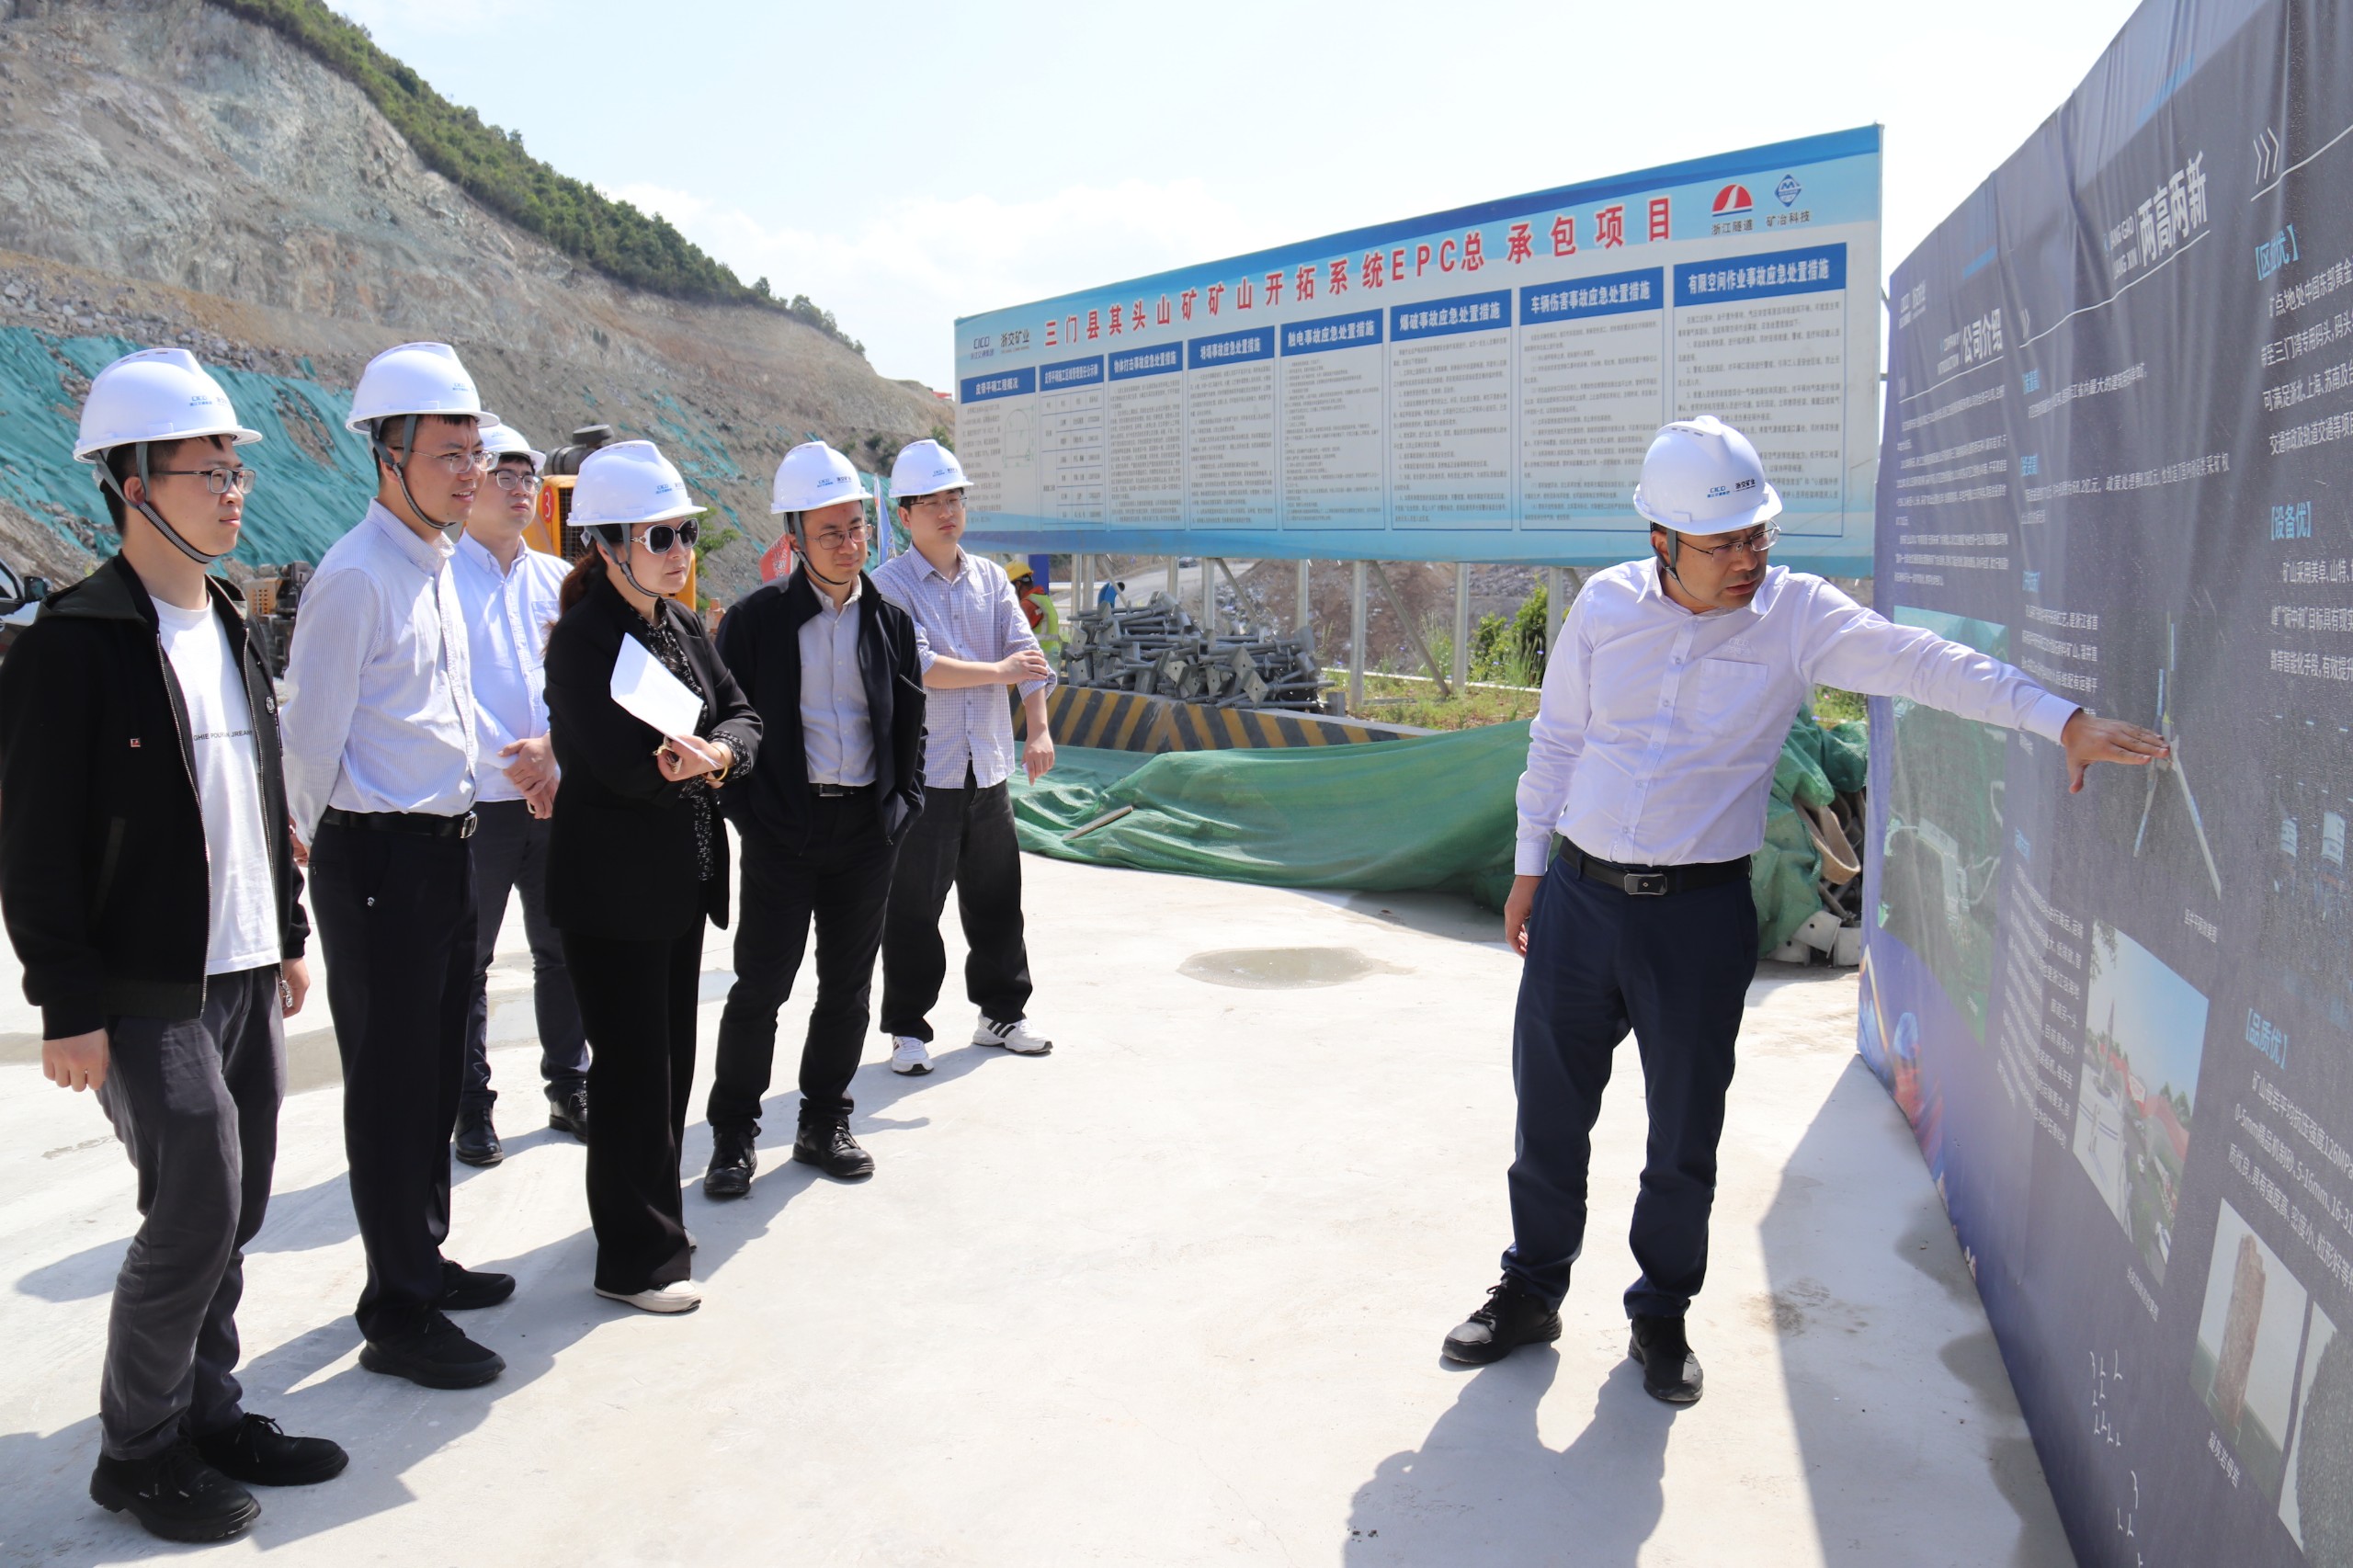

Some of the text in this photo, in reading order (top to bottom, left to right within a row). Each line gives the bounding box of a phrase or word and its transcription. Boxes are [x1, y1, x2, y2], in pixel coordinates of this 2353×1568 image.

[1711, 210, 1810, 235] 浙江隧道 矿冶科技
[2138, 150, 2207, 267] 两高两新
[1688, 257, 1829, 294] 有限空间作业事故应急处置措施
[1530, 282, 1651, 314] 车辆伤害事故应急处置措施
[1399, 301, 1501, 331] 爆破事故应急处置措施
[1000, 329, 1029, 347] 浙交矿业
[1288, 320, 1374, 347] 触电事故应急处置措施
[1963, 308, 2003, 363] 公司介绍
[544, 492, 551, 518] 3
[2271, 501, 2312, 540] 【设备优】
[2246, 1007, 2288, 1070] 【品质优】
